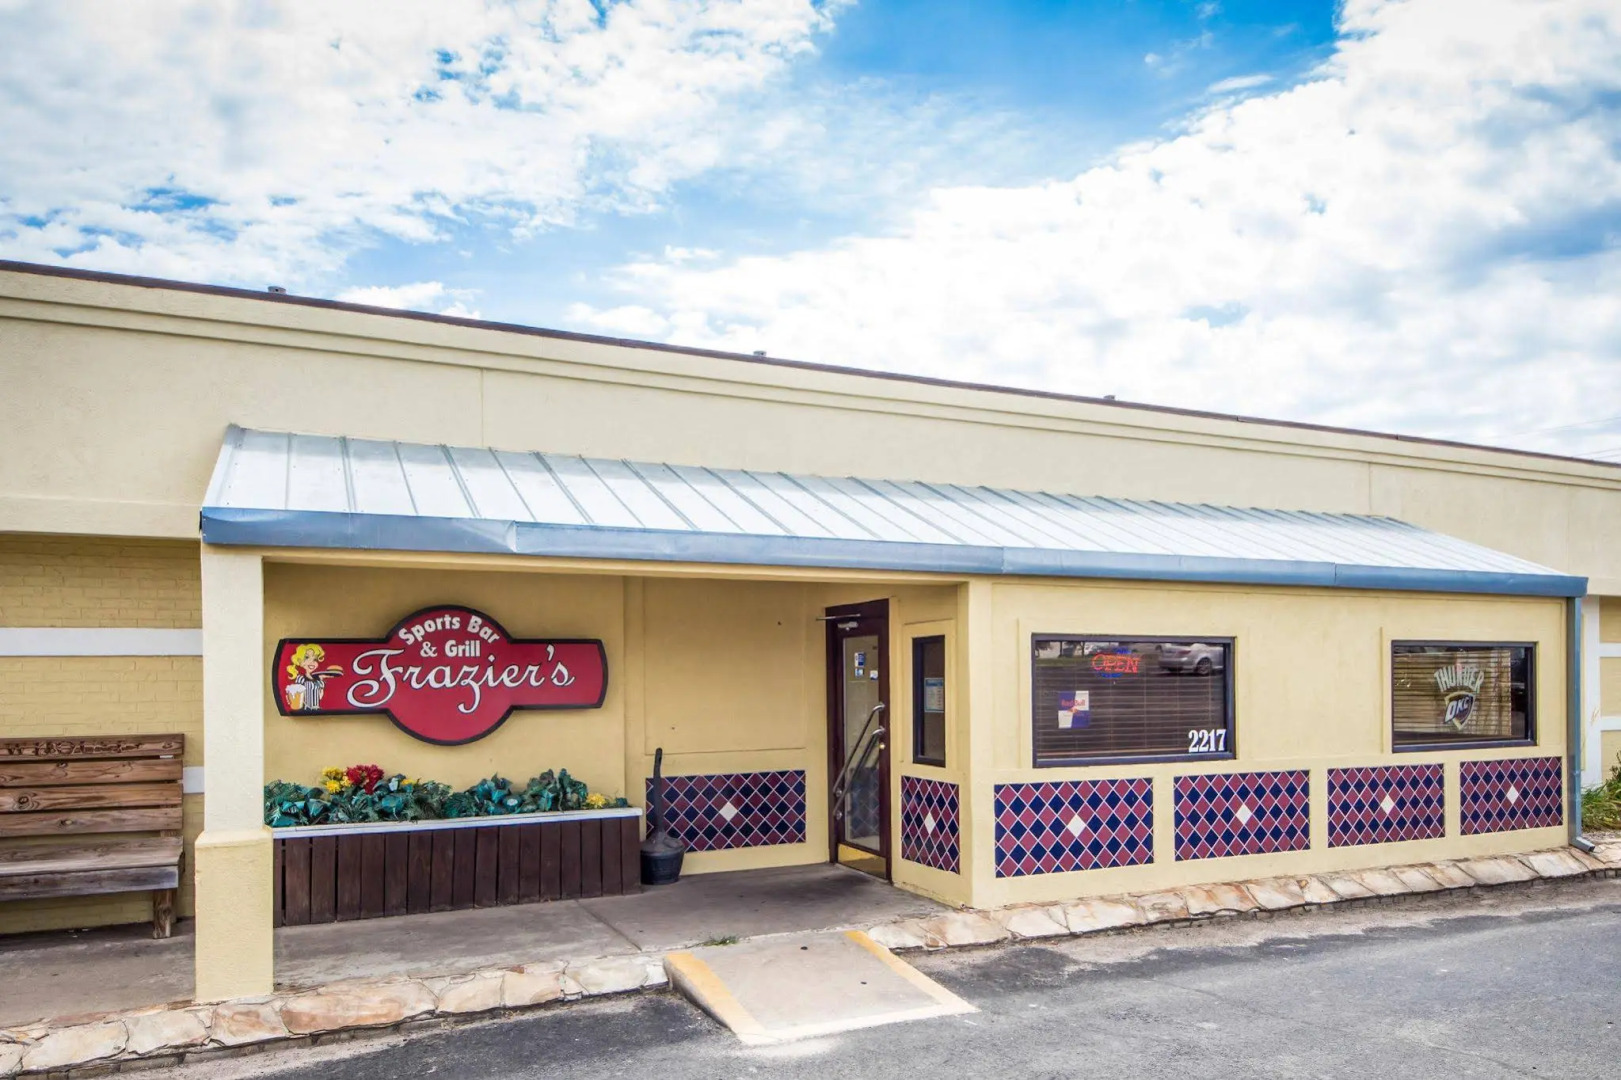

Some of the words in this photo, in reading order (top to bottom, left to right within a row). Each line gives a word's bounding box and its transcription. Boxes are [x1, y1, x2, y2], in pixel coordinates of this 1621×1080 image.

[398, 614, 461, 645] Sports
[468, 615, 500, 644] Bar
[420, 641, 438, 658] &
[444, 639, 481, 658] Grill
[1092, 654, 1140, 673] OPEN
[346, 645, 575, 714] Frazier's
[1433, 664, 1485, 694] THUNDER
[1074, 699, 1086, 707] Bull
[1444, 696, 1470, 722] OKC
[1188, 729, 1226, 753] 2217
